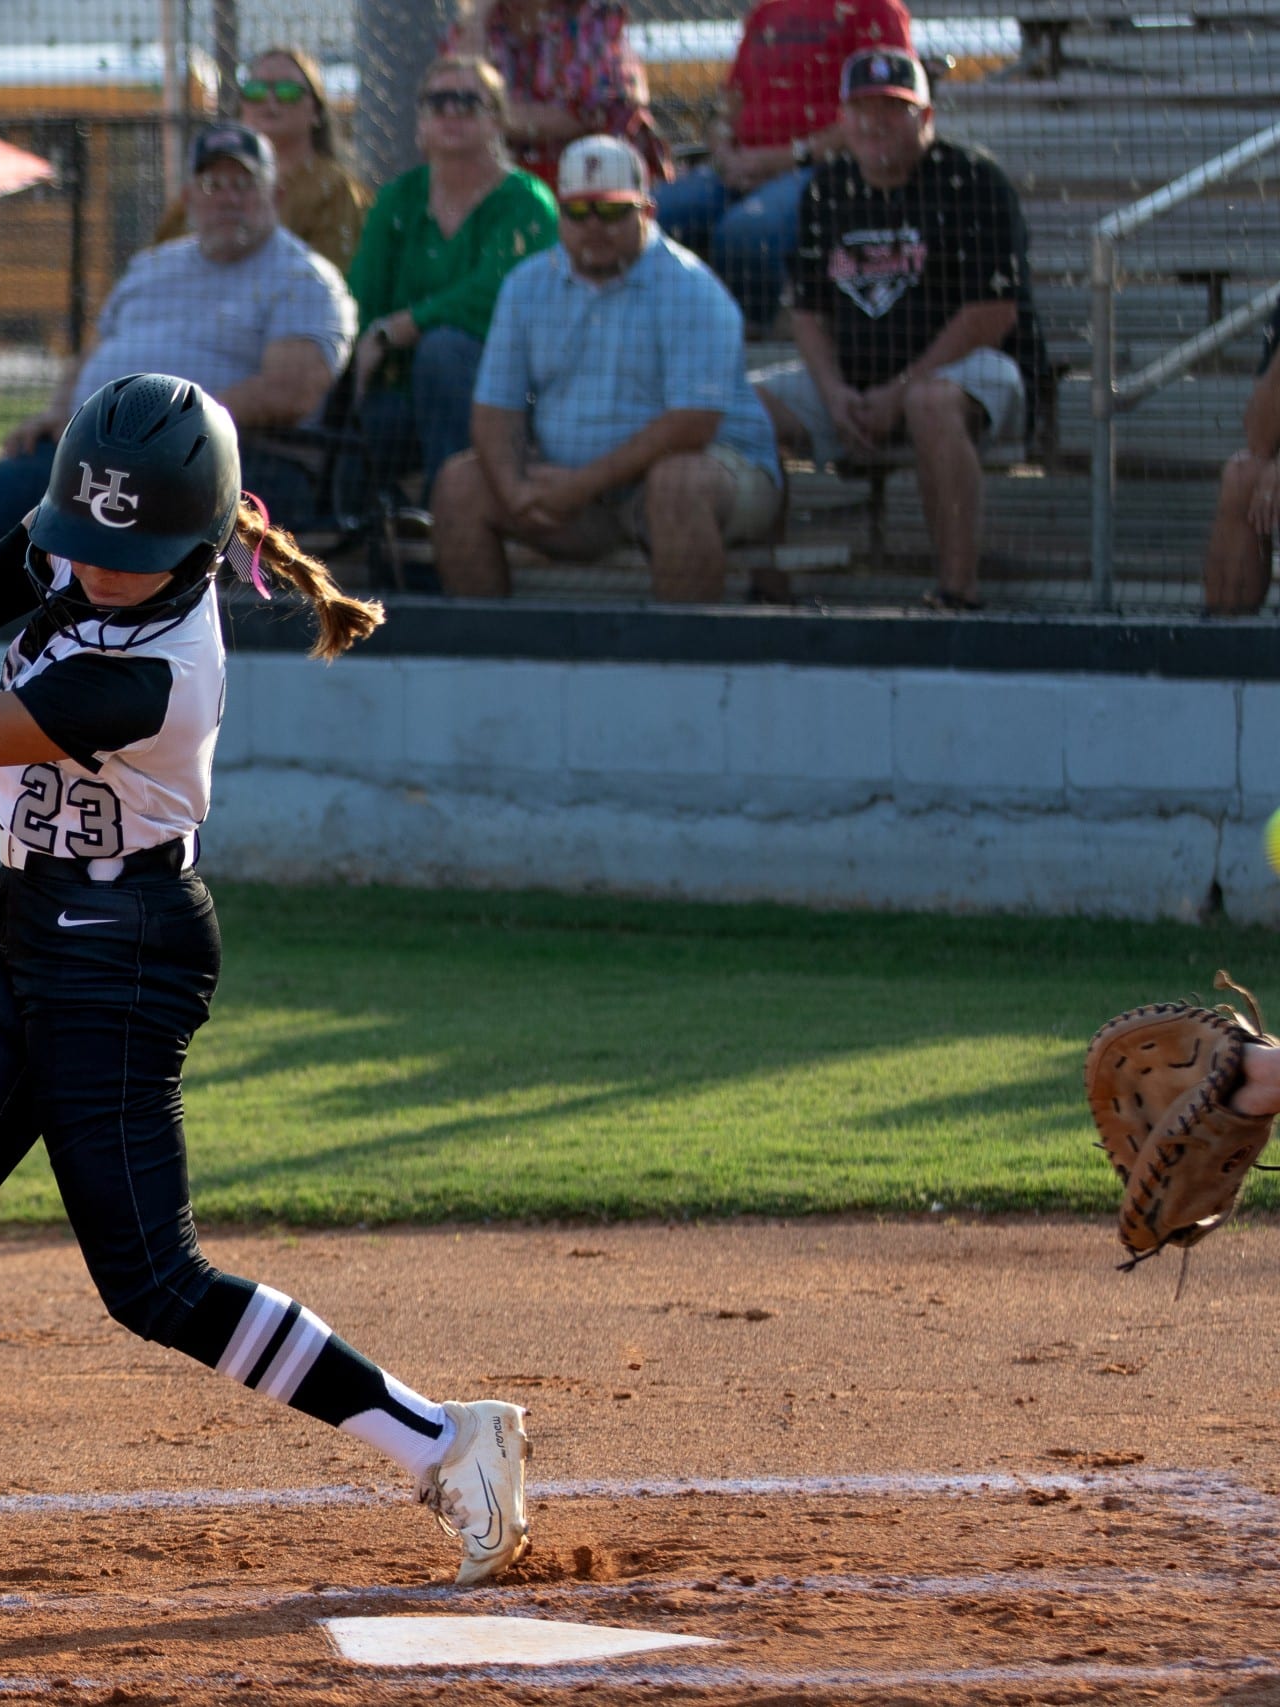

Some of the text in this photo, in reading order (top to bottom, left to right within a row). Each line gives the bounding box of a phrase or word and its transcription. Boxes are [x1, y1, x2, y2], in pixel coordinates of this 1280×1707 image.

[72, 461, 139, 528] HC
[10, 762, 124, 859] 23
[492, 1415, 505, 1449] renew
